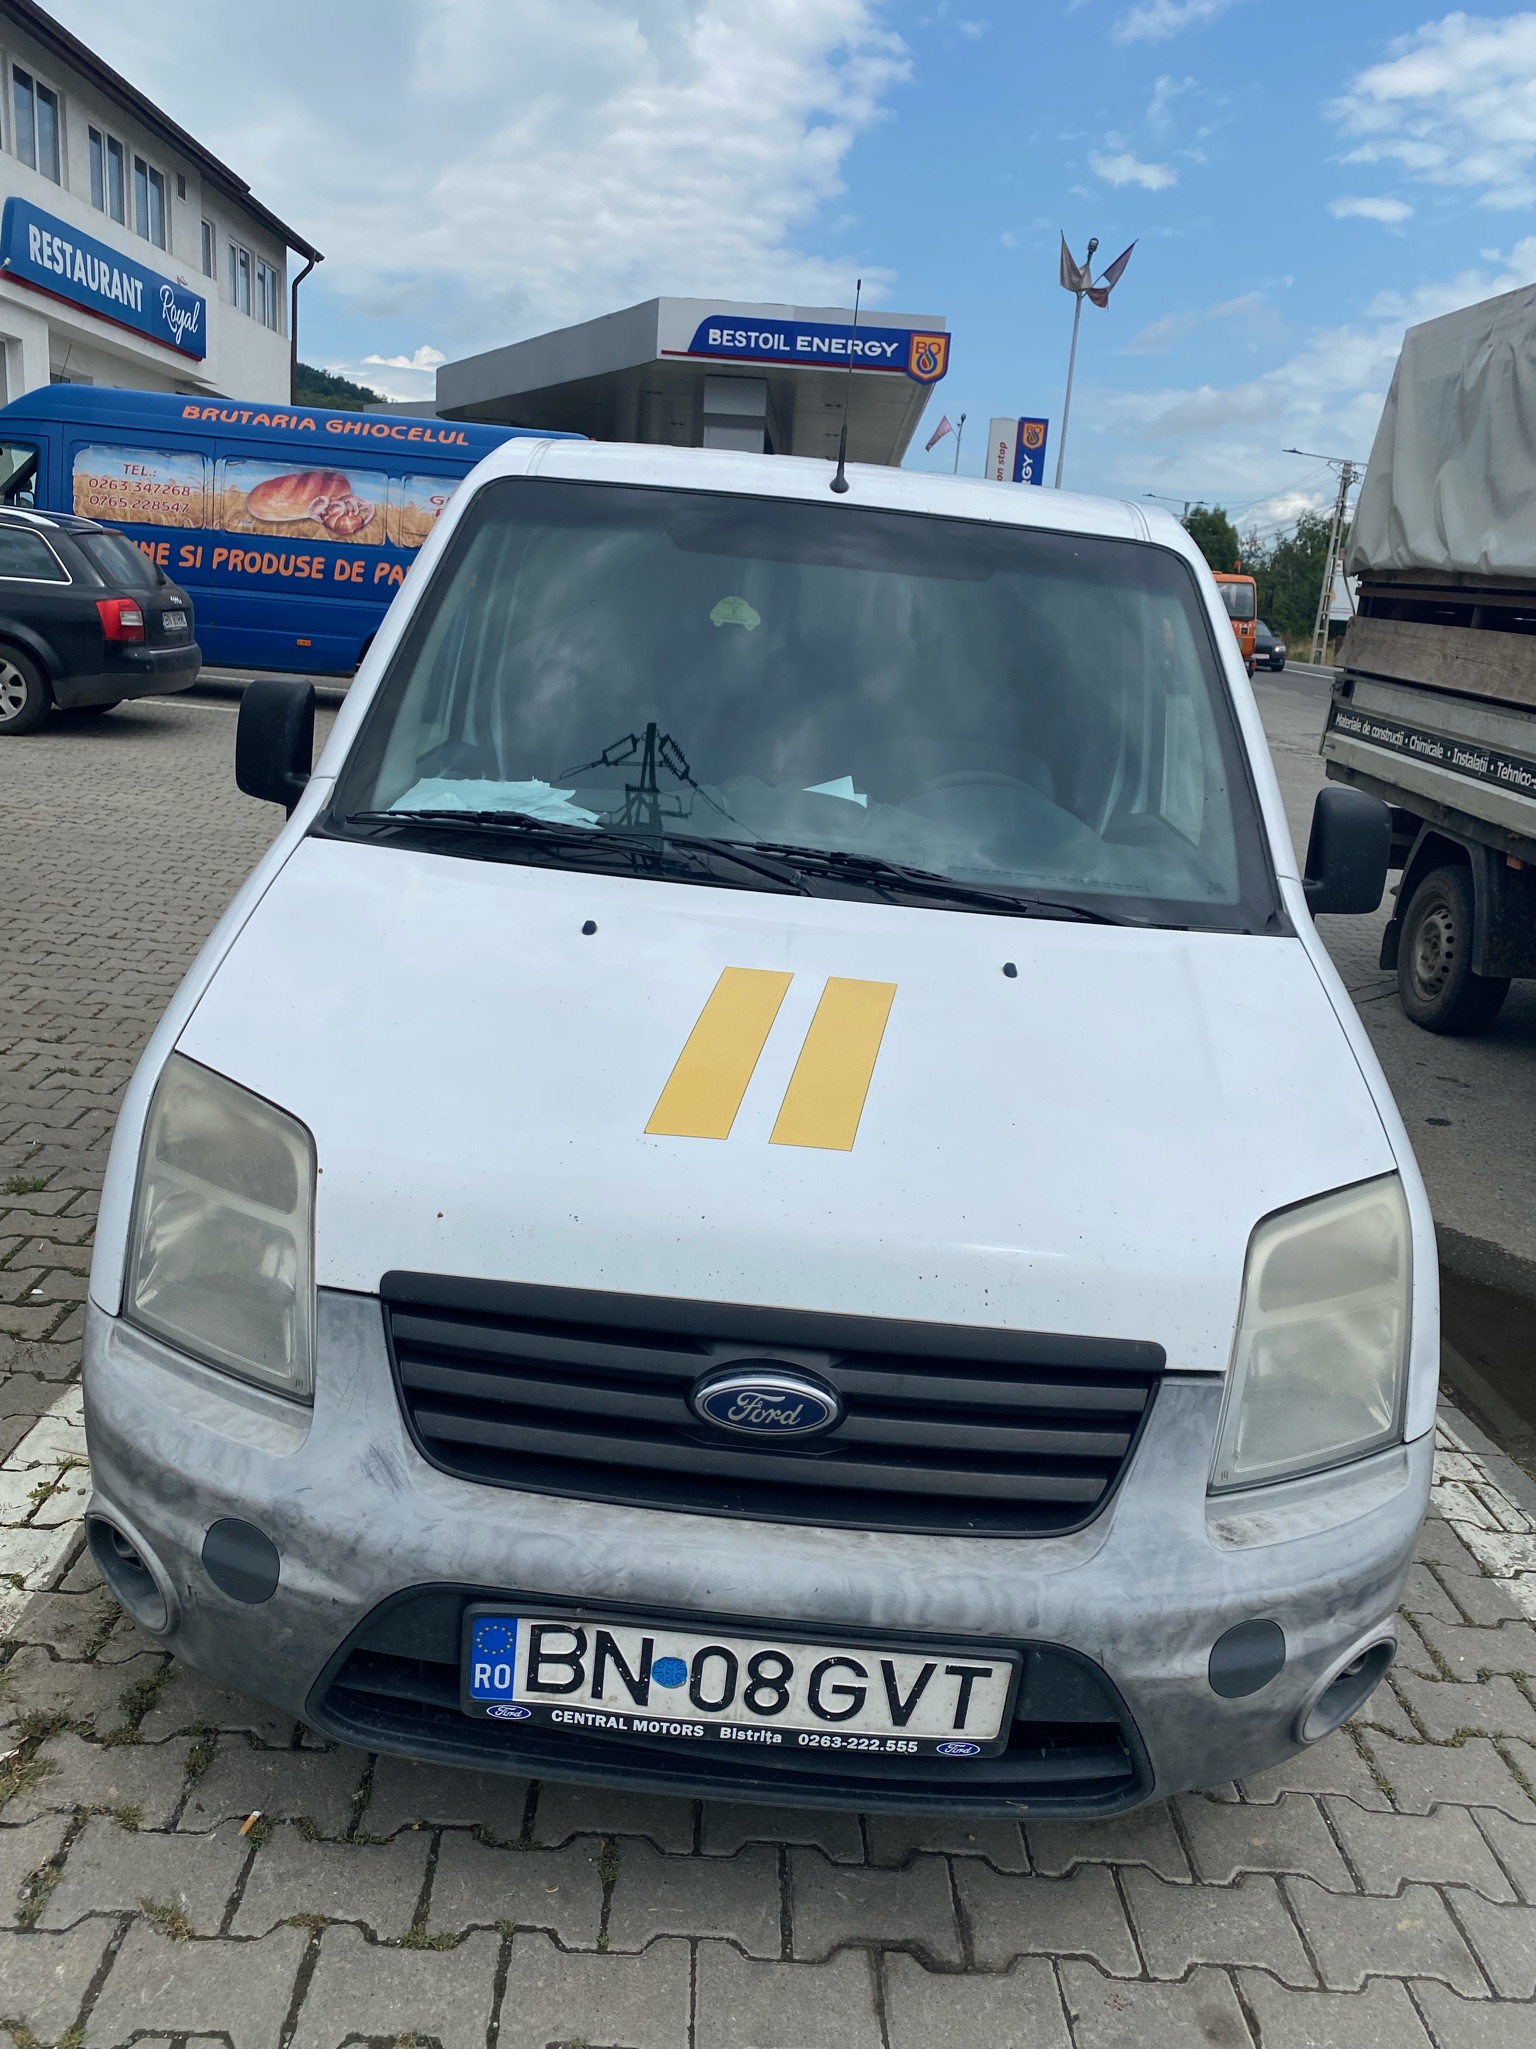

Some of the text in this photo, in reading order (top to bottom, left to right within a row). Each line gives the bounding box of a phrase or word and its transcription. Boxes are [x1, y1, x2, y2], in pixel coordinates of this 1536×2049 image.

[28, 223, 143, 312] RESTAURANT
[160, 284, 200, 344] Royal
[708, 328, 899, 357] BESTOIL ENERGY
[182, 405, 469, 446] BRUTARIA GHIOCELUL
[123, 464, 157, 477] TEL.:
[88, 478, 190, 496] 0263.347268
[89, 495, 190, 513] 0765.228547
[178, 545, 203, 568] SI
[212, 547, 326, 580] PRODUSE
[334, 559, 366, 583] DE
[374, 562, 412, 586] PA
[1335, 712, 1361, 732] Materiale
[1362, 720, 1371, 735] de
[1409, 735, 1444, 758] Chimicale
[727, 1391, 804, 1425] Ford
[474, 1662, 511, 1689] RO
[494, 1706, 524, 1717] Ford
[551, 1709, 627, 1730] CENTRAL
[633, 1719, 704, 1737] MOTORS
[798, 1733, 918, 1753] 0263-222.555
[944, 1744, 973, 1754] Ford
